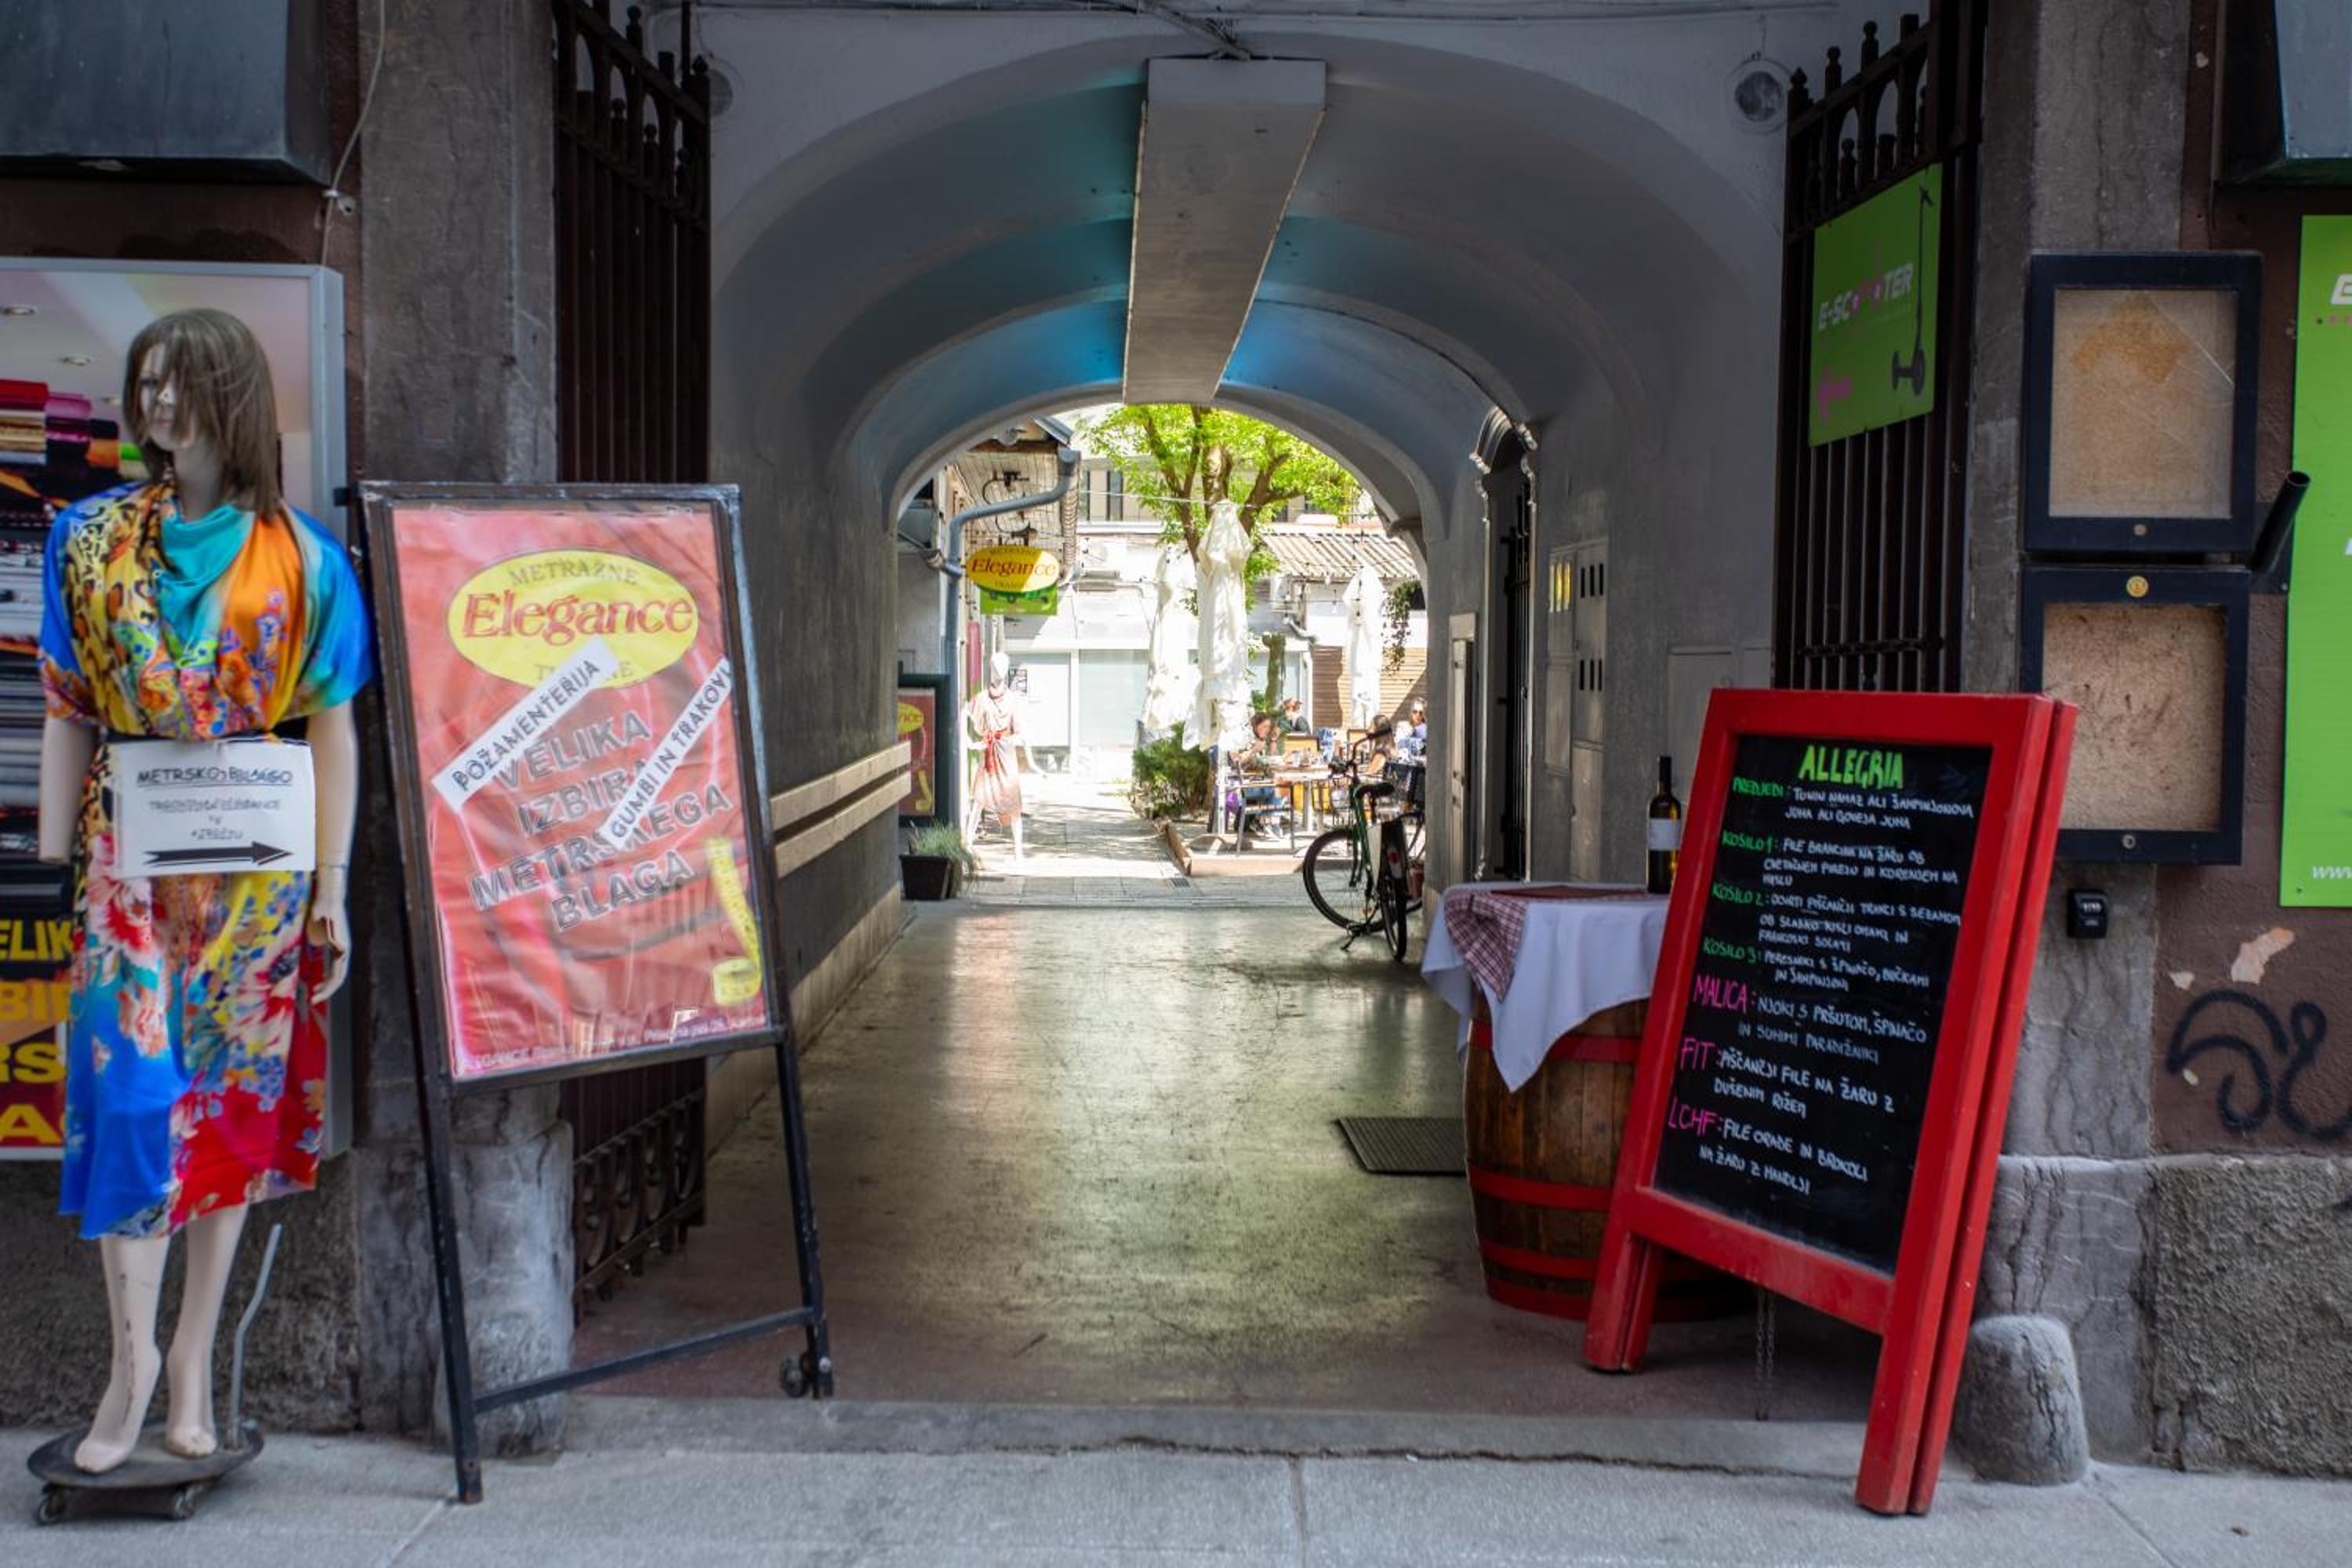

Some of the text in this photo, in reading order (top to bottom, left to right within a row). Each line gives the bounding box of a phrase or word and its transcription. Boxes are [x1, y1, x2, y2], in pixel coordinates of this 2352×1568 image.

[971, 557, 1056, 577] Elegance
[463, 589, 695, 646] Elegance
[492, 710, 652, 790] VELIKA
[1798, 744, 1903, 789] ALLEGRIA
[610, 773, 660, 839] GUMBI
[654, 746, 678, 775] IN
[1867, 794, 1886, 808] ALI
[551, 848, 695, 931] BLAGA
[1758, 996, 1795, 1017] NJOKI
[1798, 1004, 1809, 1019] S
[0, 1042, 66, 1083] S
[1780, 1065, 1811, 1087] FILE
[1814, 1077, 1834, 1094] NA
[1723, 1117, 1752, 1139] FILE
